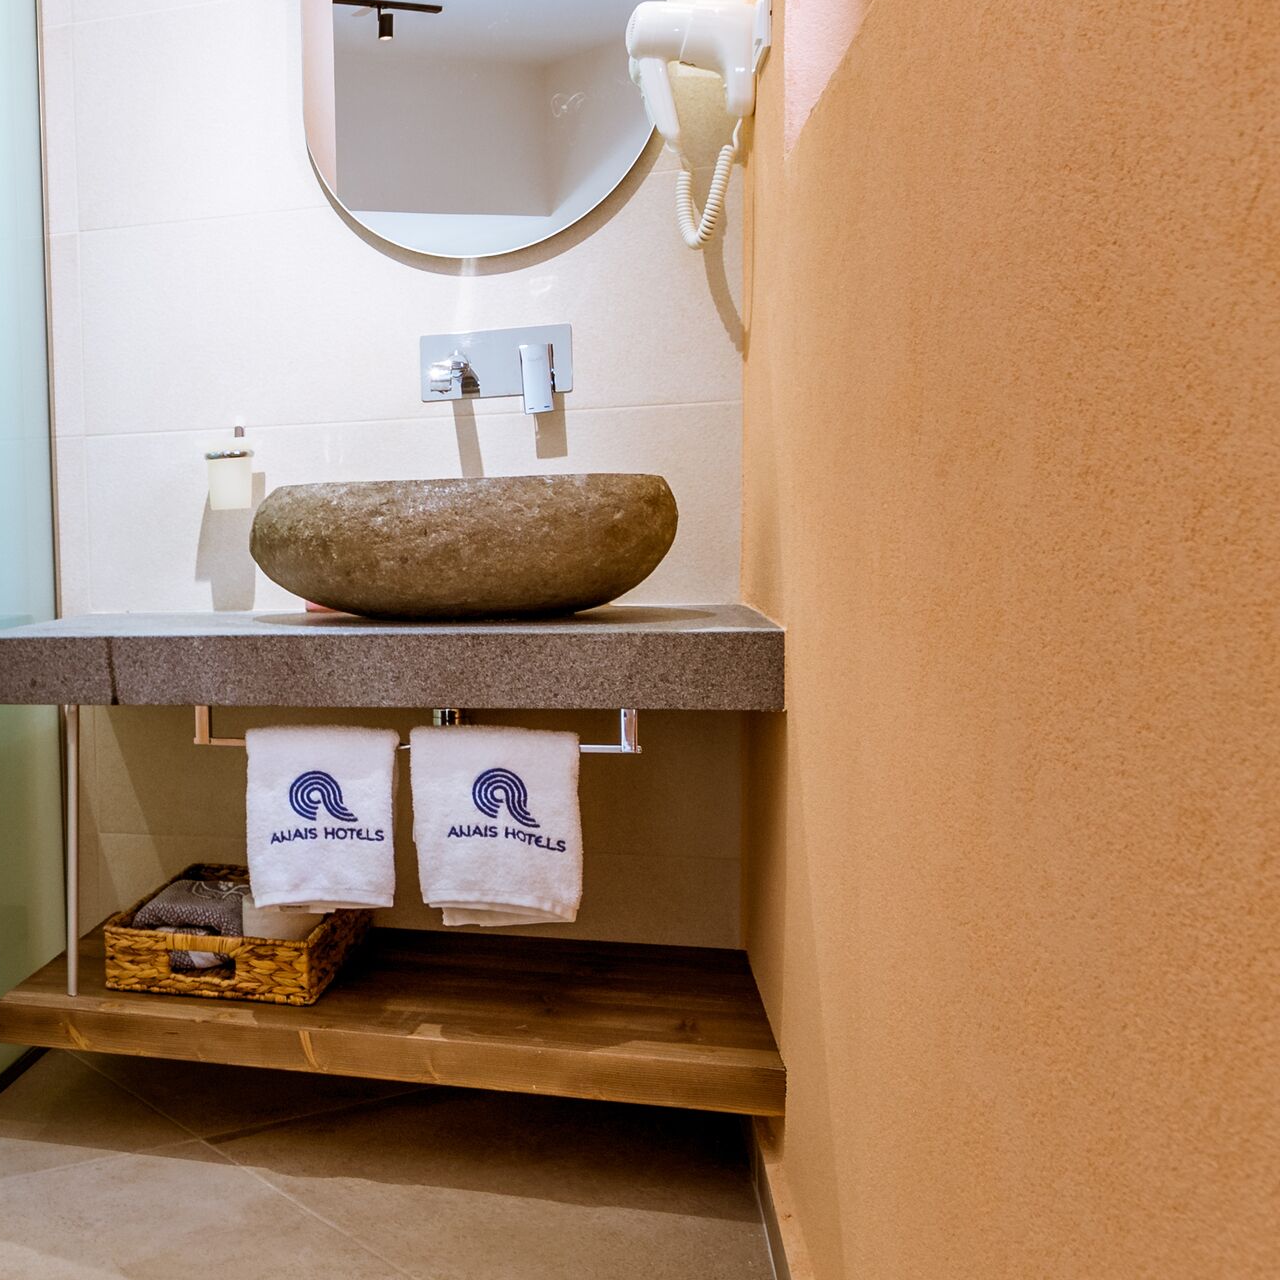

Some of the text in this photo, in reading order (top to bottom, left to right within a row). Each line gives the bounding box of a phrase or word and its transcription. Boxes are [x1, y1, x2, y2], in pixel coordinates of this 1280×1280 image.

[270, 826, 385, 845] ANAIS HOTELS
[447, 825, 567, 853] ANAIS HOTELS
